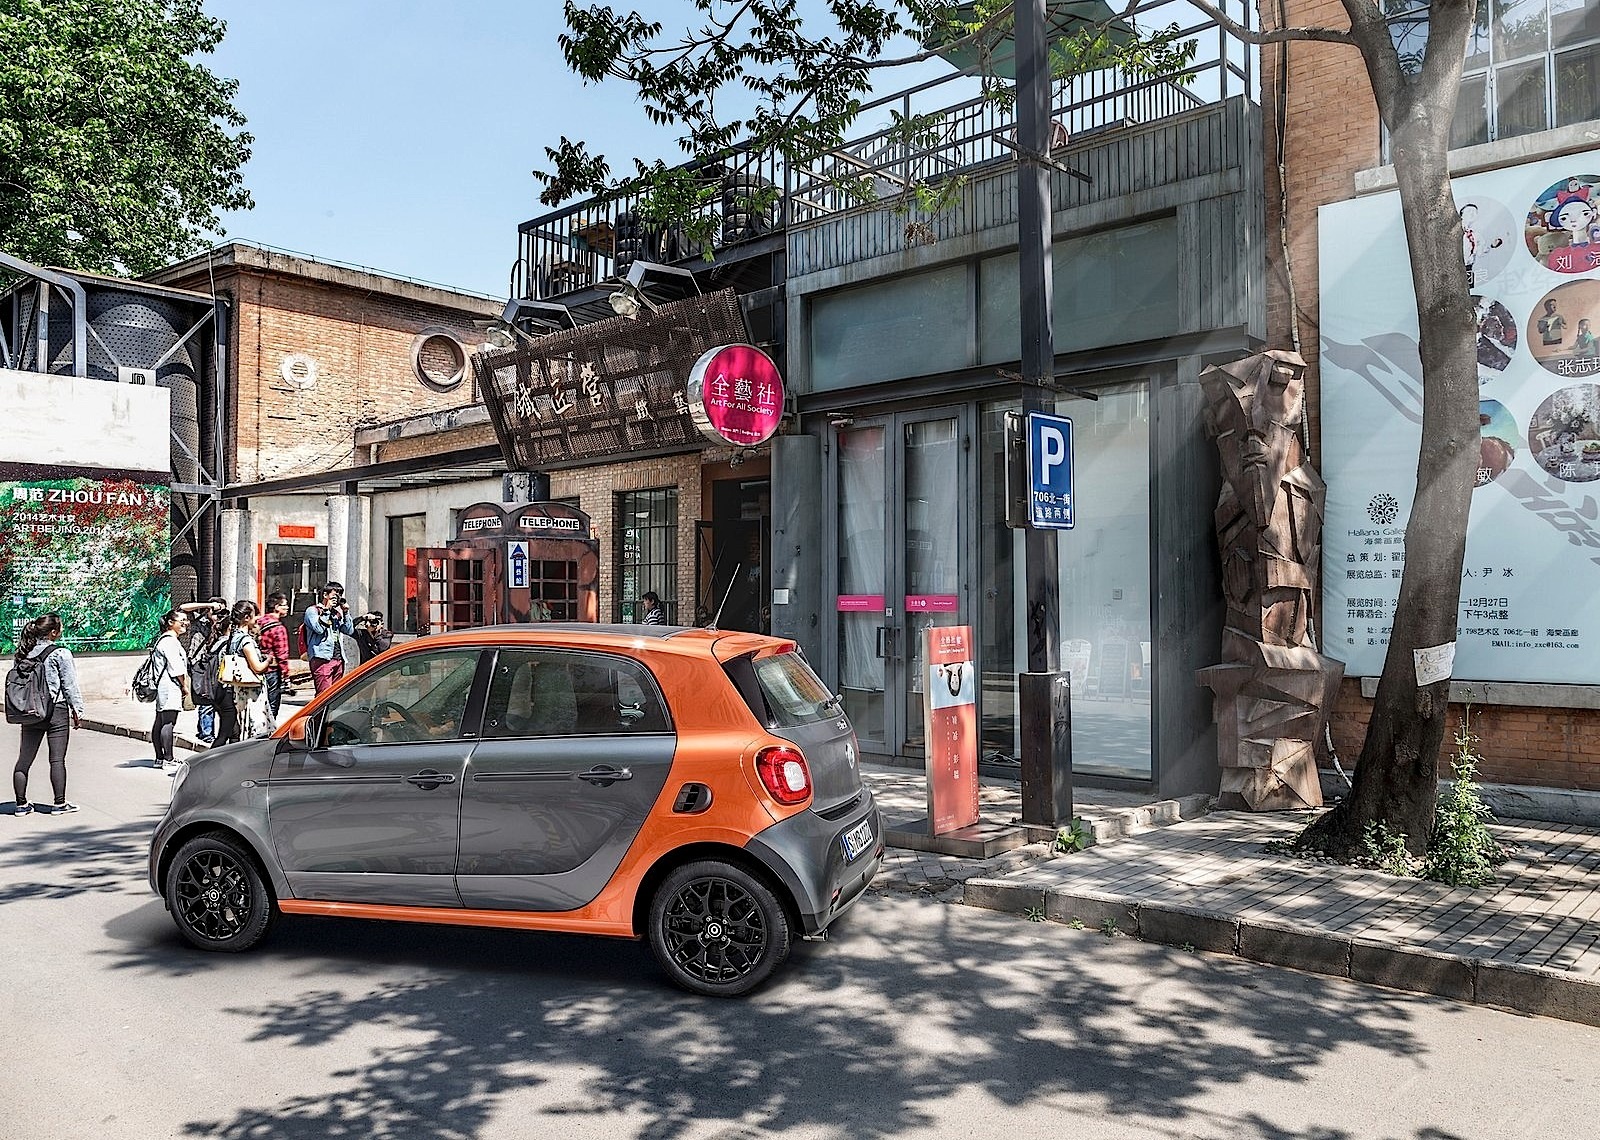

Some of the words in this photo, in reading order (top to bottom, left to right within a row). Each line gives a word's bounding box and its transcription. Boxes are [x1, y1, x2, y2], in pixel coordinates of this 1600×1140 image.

[1556, 254, 1572, 271] 刘
[711, 374, 775, 406] 全藝社
[711, 398, 722, 407] Art
[723, 400, 735, 409] For
[736, 402, 746, 410] All
[747, 405, 774, 416] Society
[1041, 425, 1065, 485] P
[1560, 463, 1576, 477] 陈
[12, 487, 44, 501] 周范
[48, 489, 102, 504] ZHOU
[107, 492, 142, 506] FAN
[1034, 491, 1070, 506] 706北一街
[13, 513, 76, 523] 2014艺术北京
[464, 517, 501, 530] TELEPHONE
[522, 517, 579, 529] TELEPHONE
[1463, 609, 1509, 620] 下午3点整
[1503, 628, 1539, 637] 706北一街
